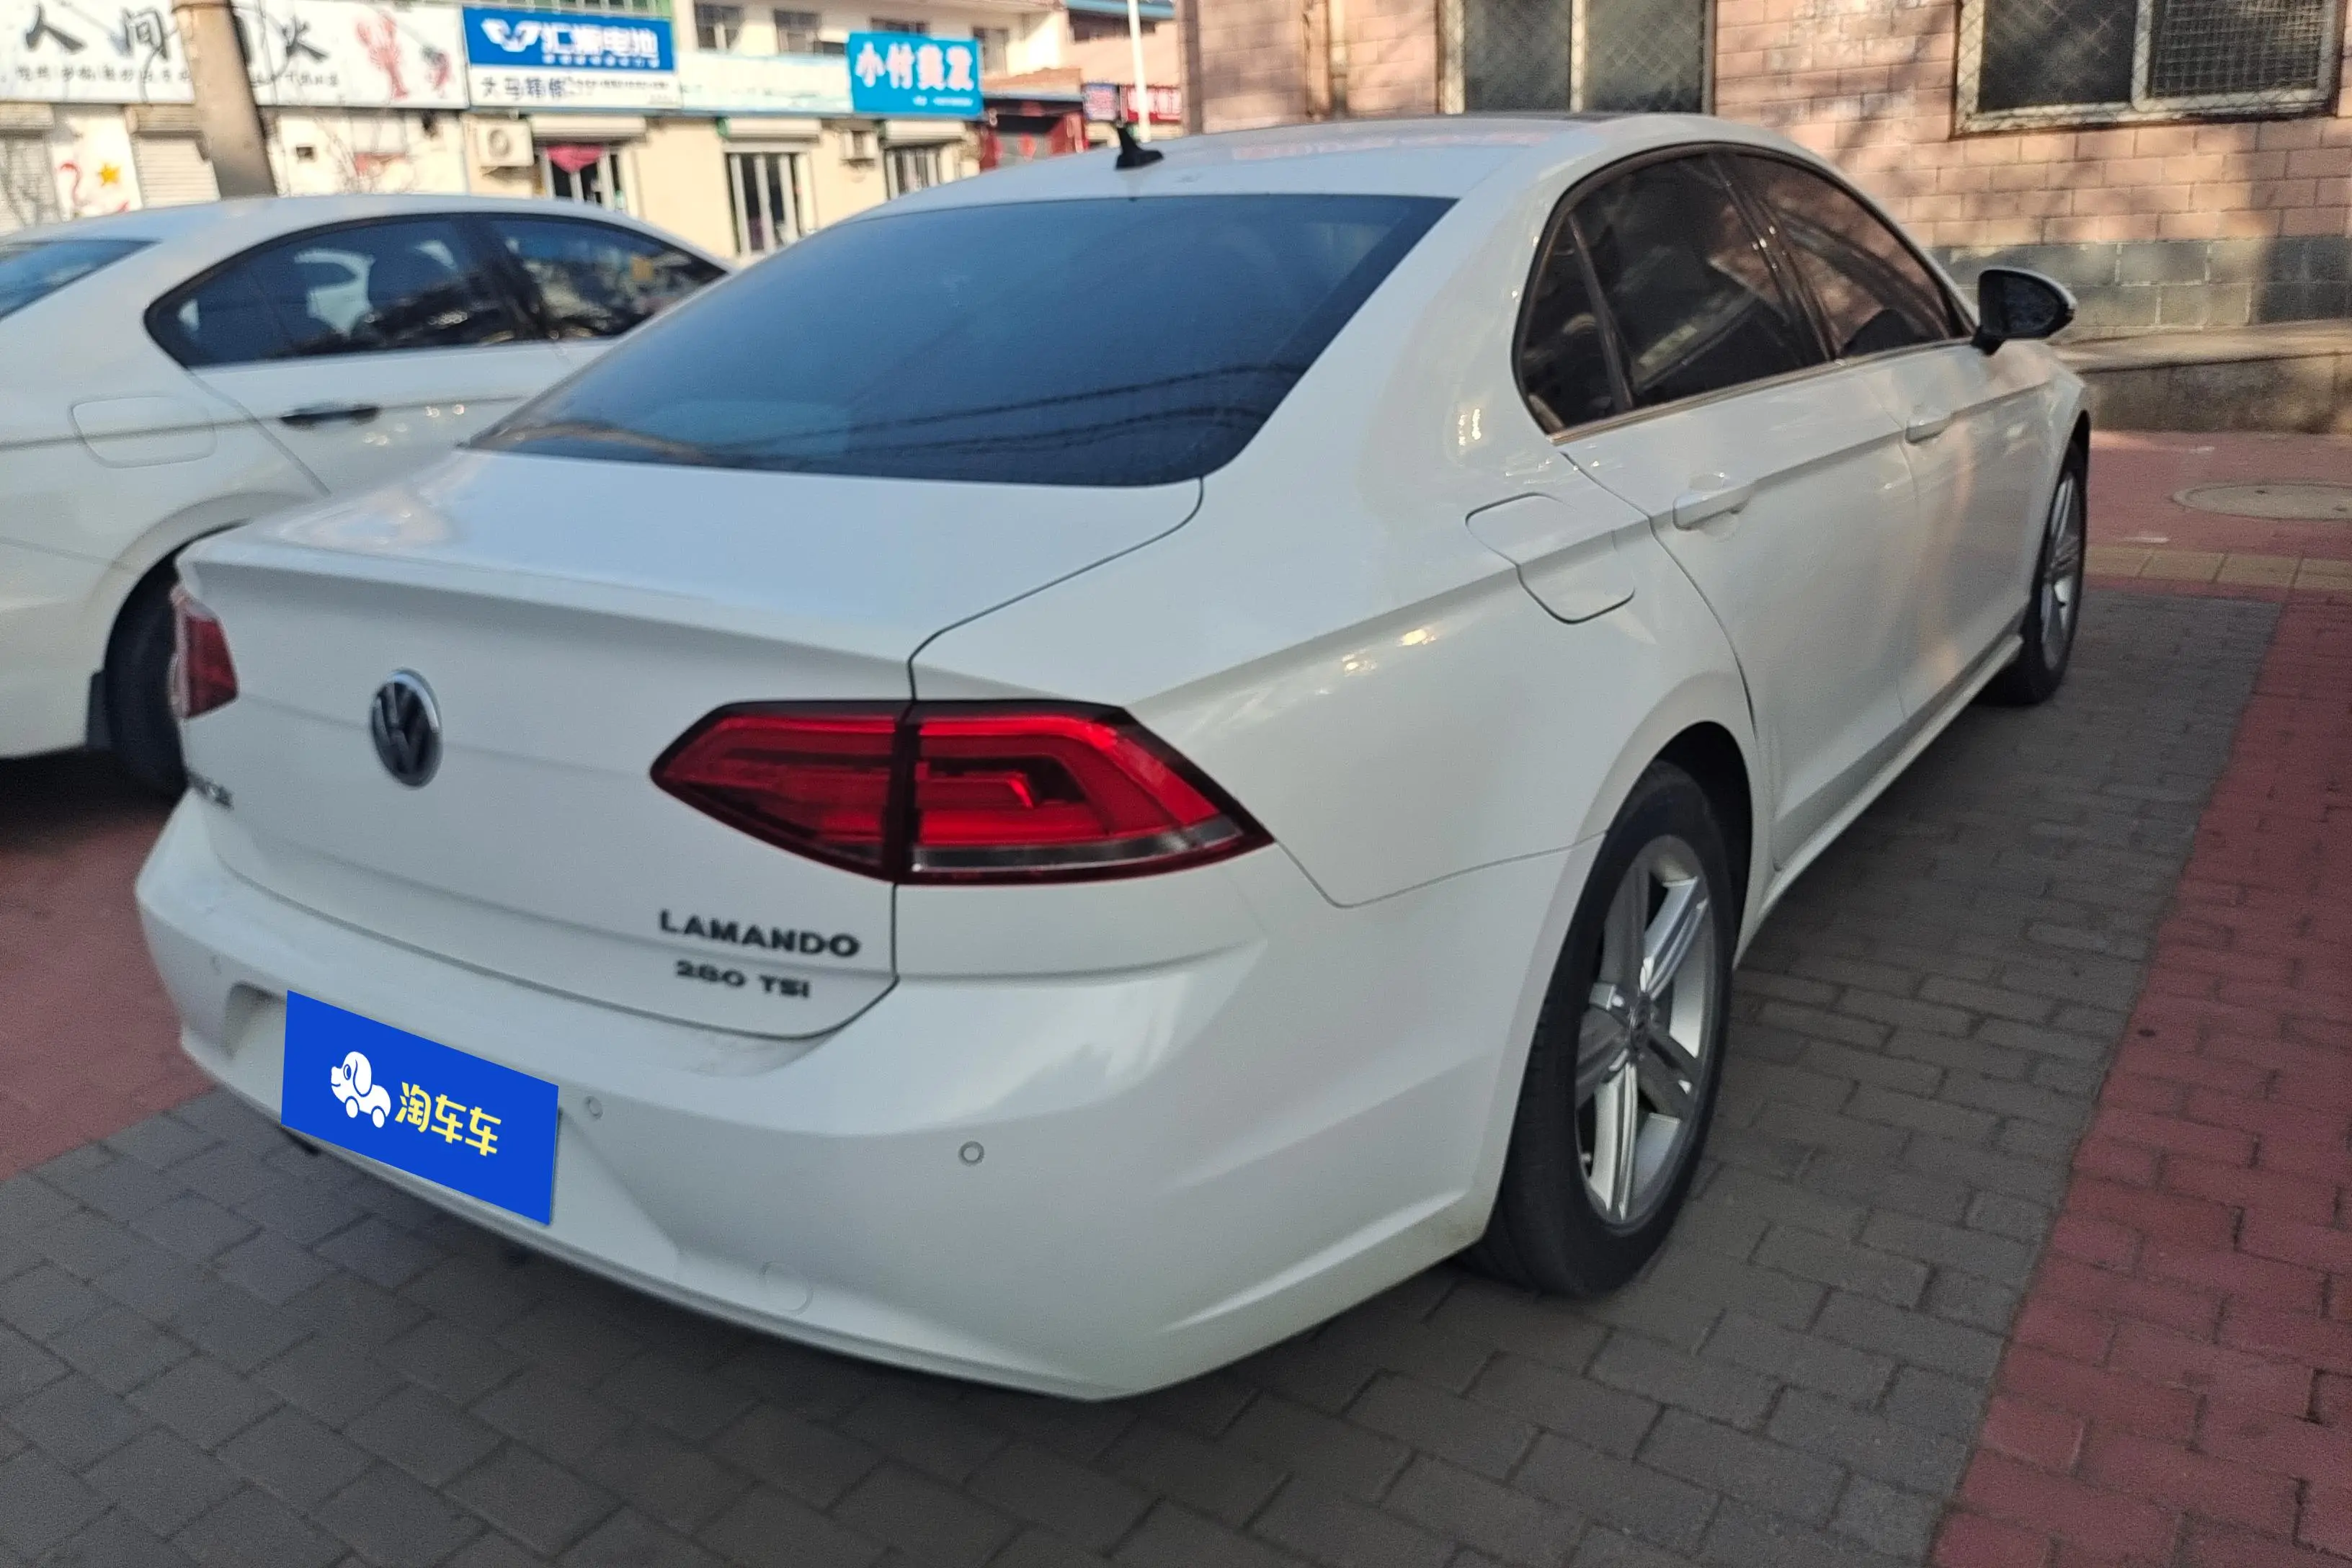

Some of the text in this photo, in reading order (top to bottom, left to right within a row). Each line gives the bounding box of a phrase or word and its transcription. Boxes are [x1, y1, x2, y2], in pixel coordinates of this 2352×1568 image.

[24, 4, 329, 63] 人间火
[660, 909, 860, 957] LAMANDO
[760, 974, 809, 998] TSI
